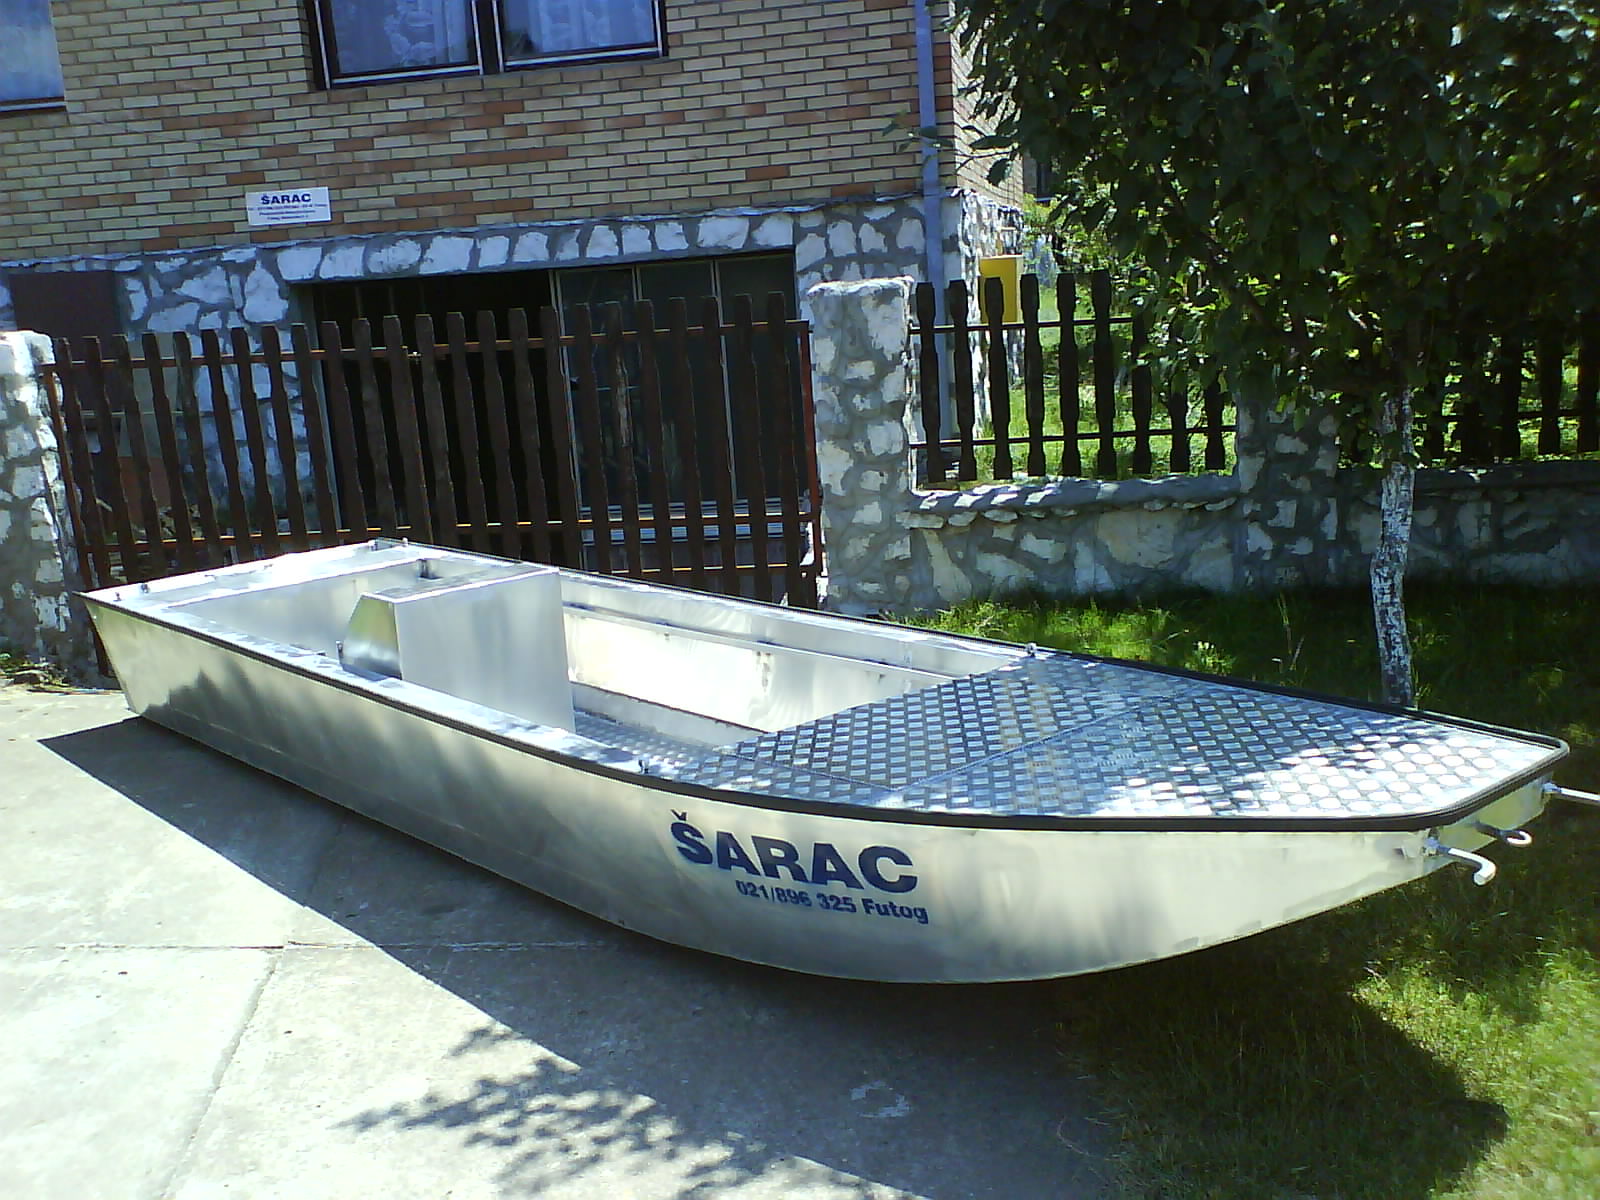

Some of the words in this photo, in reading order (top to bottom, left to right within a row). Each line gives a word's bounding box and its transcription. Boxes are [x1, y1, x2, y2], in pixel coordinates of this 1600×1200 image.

[261, 193, 311, 205] ŠARAC
[670, 809, 918, 893] ŠARAC
[735, 880, 812, 907] 021/896
[817, 893, 857, 913] 325
[861, 898, 929, 924] Futog
